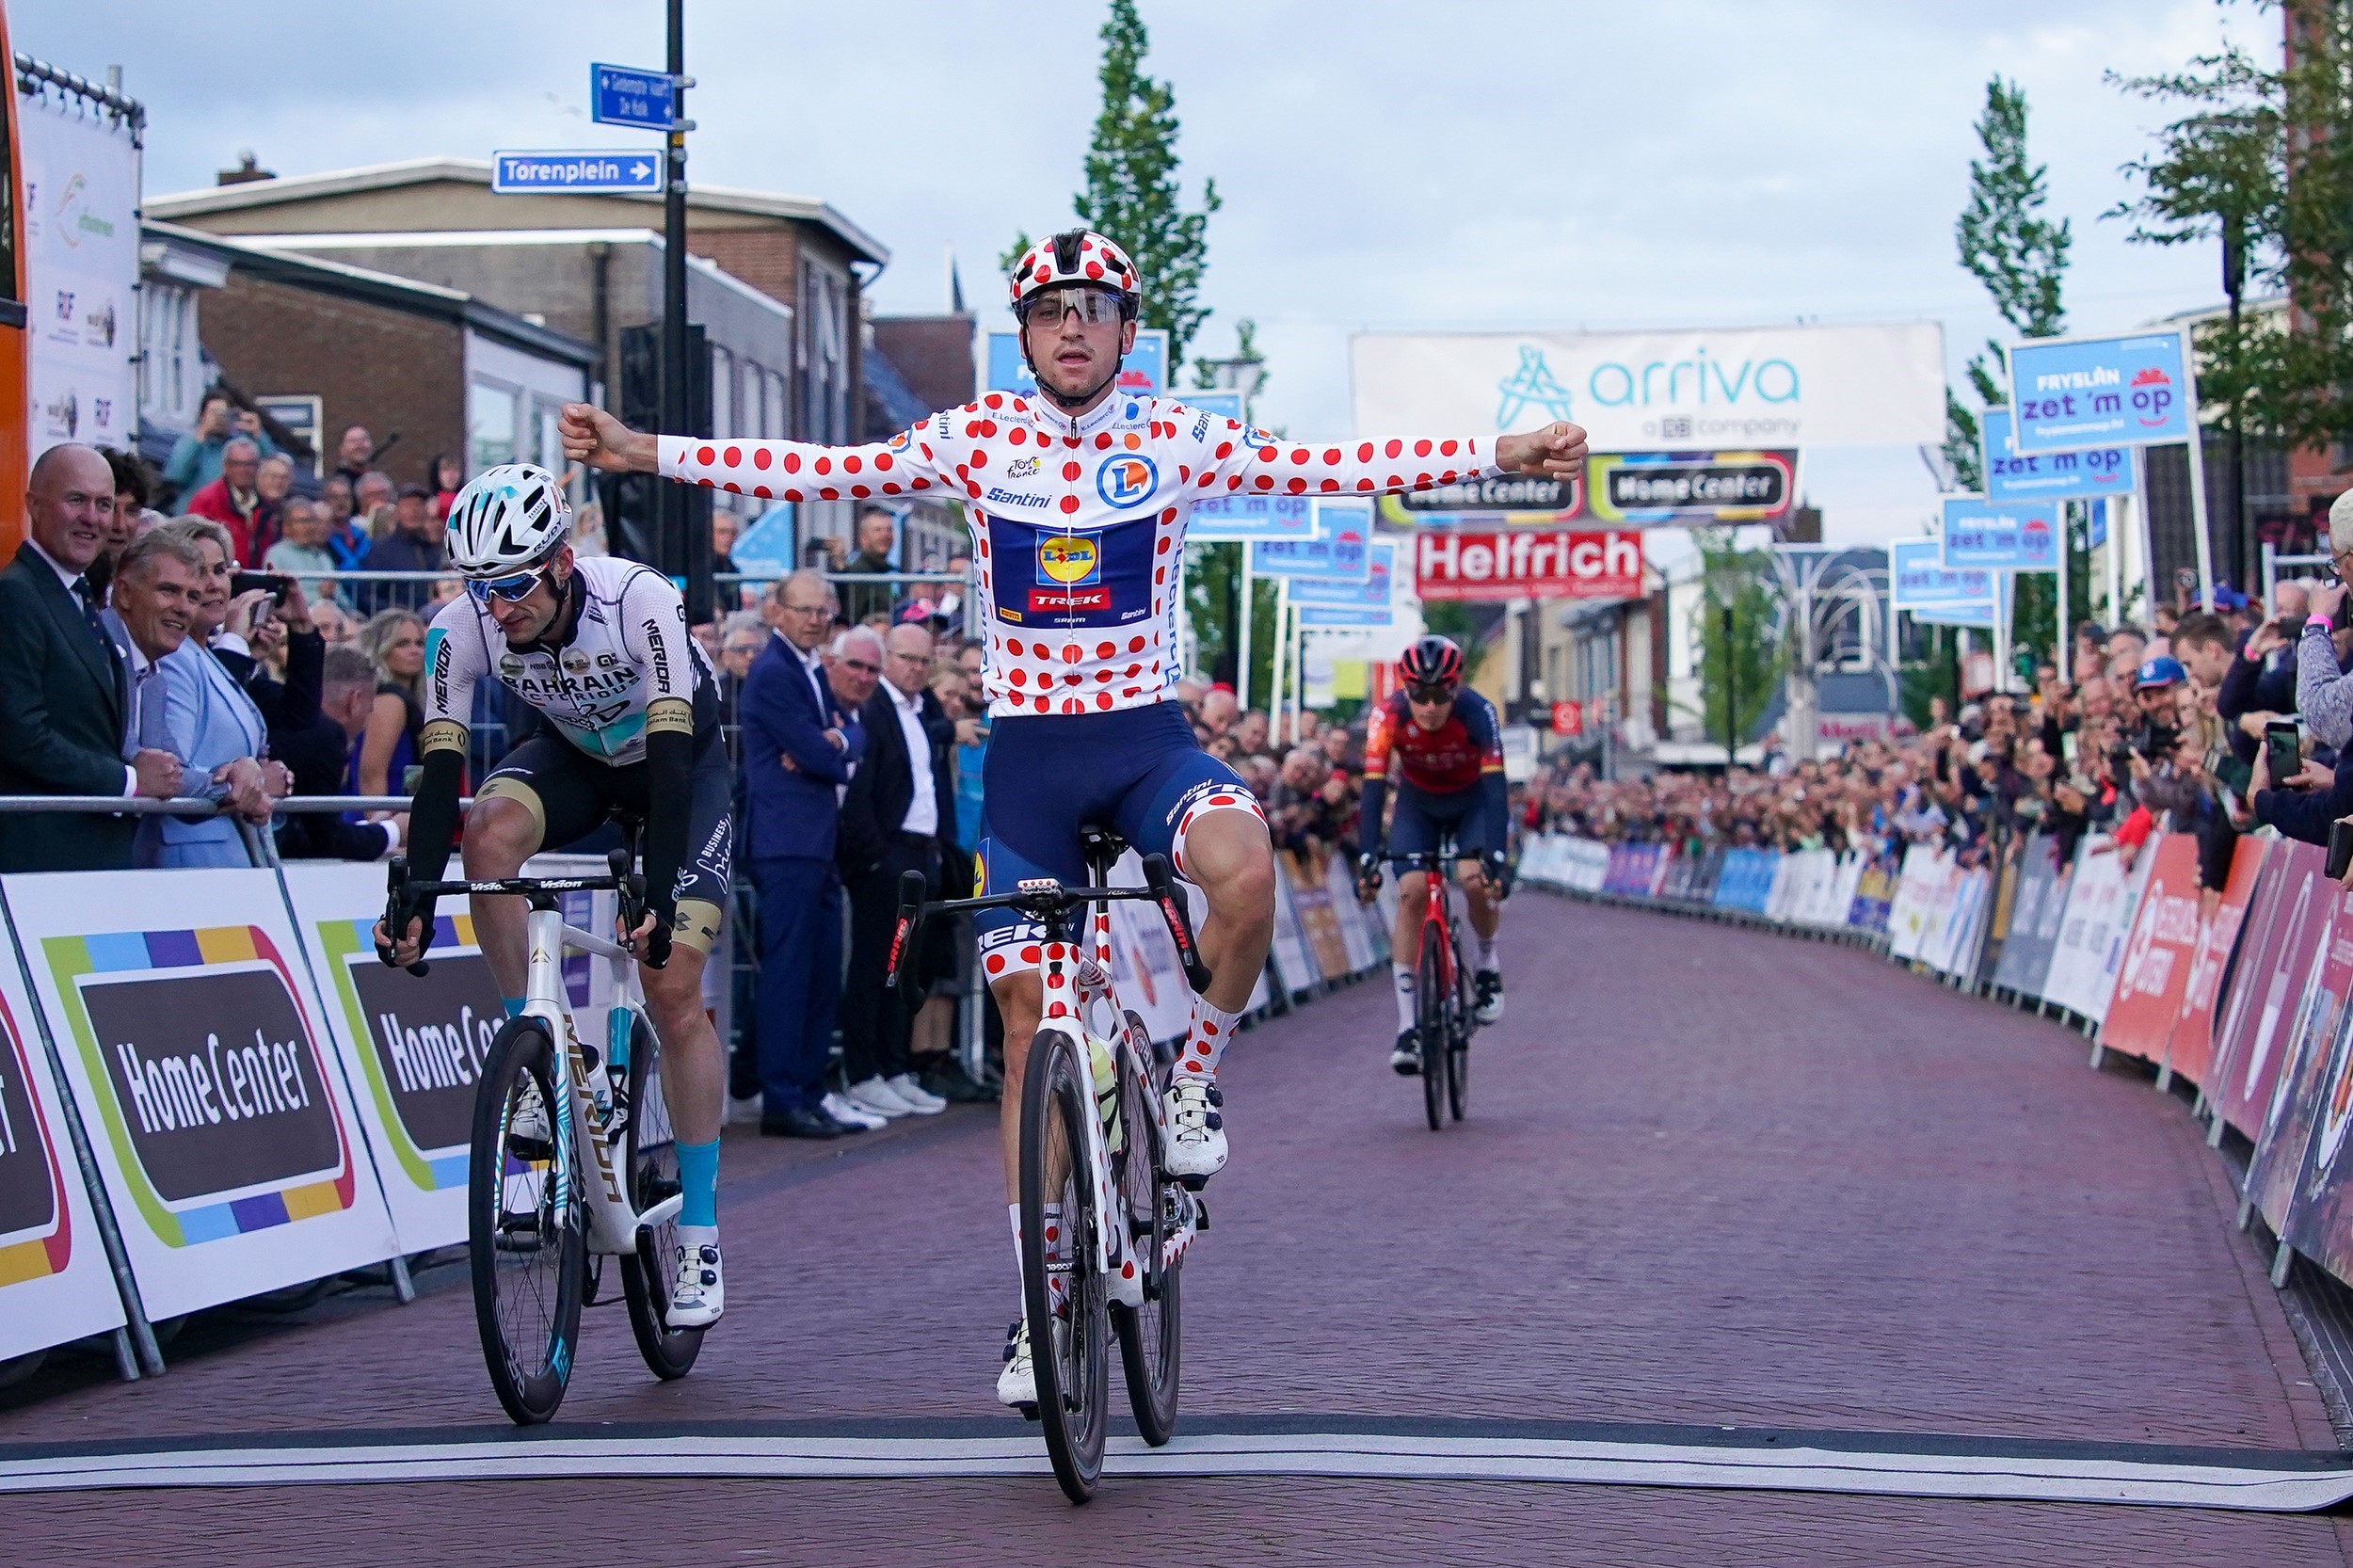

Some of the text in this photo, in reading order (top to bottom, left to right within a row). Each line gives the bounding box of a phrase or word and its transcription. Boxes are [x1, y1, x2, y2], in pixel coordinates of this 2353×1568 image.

[504, 159, 619, 185] Torenplein
[1590, 346, 1800, 406] arriva
[2023, 392, 2076, 420] zet
[2132, 389, 2172, 415] op
[986, 487, 1052, 508] Santini
[534, 517, 562, 552] RUDY
[1419, 532, 1640, 580] Helfrich
[1035, 594, 1103, 605] TREK
[1121, 607, 1146, 620] Santini
[641, 618, 670, 694] MERIDA
[435, 637, 452, 714] MERIDA
[502, 667, 638, 694] BAHRAIN
[516, 676, 641, 701] ICTORIOUS
[701, 820, 727, 857] BUSINESS
[471, 883, 507, 891] Visio
[540, 880, 583, 889] Vision
[117, 1028, 310, 1133] HomeCenter
[563, 1014, 623, 1203] MERIDA
